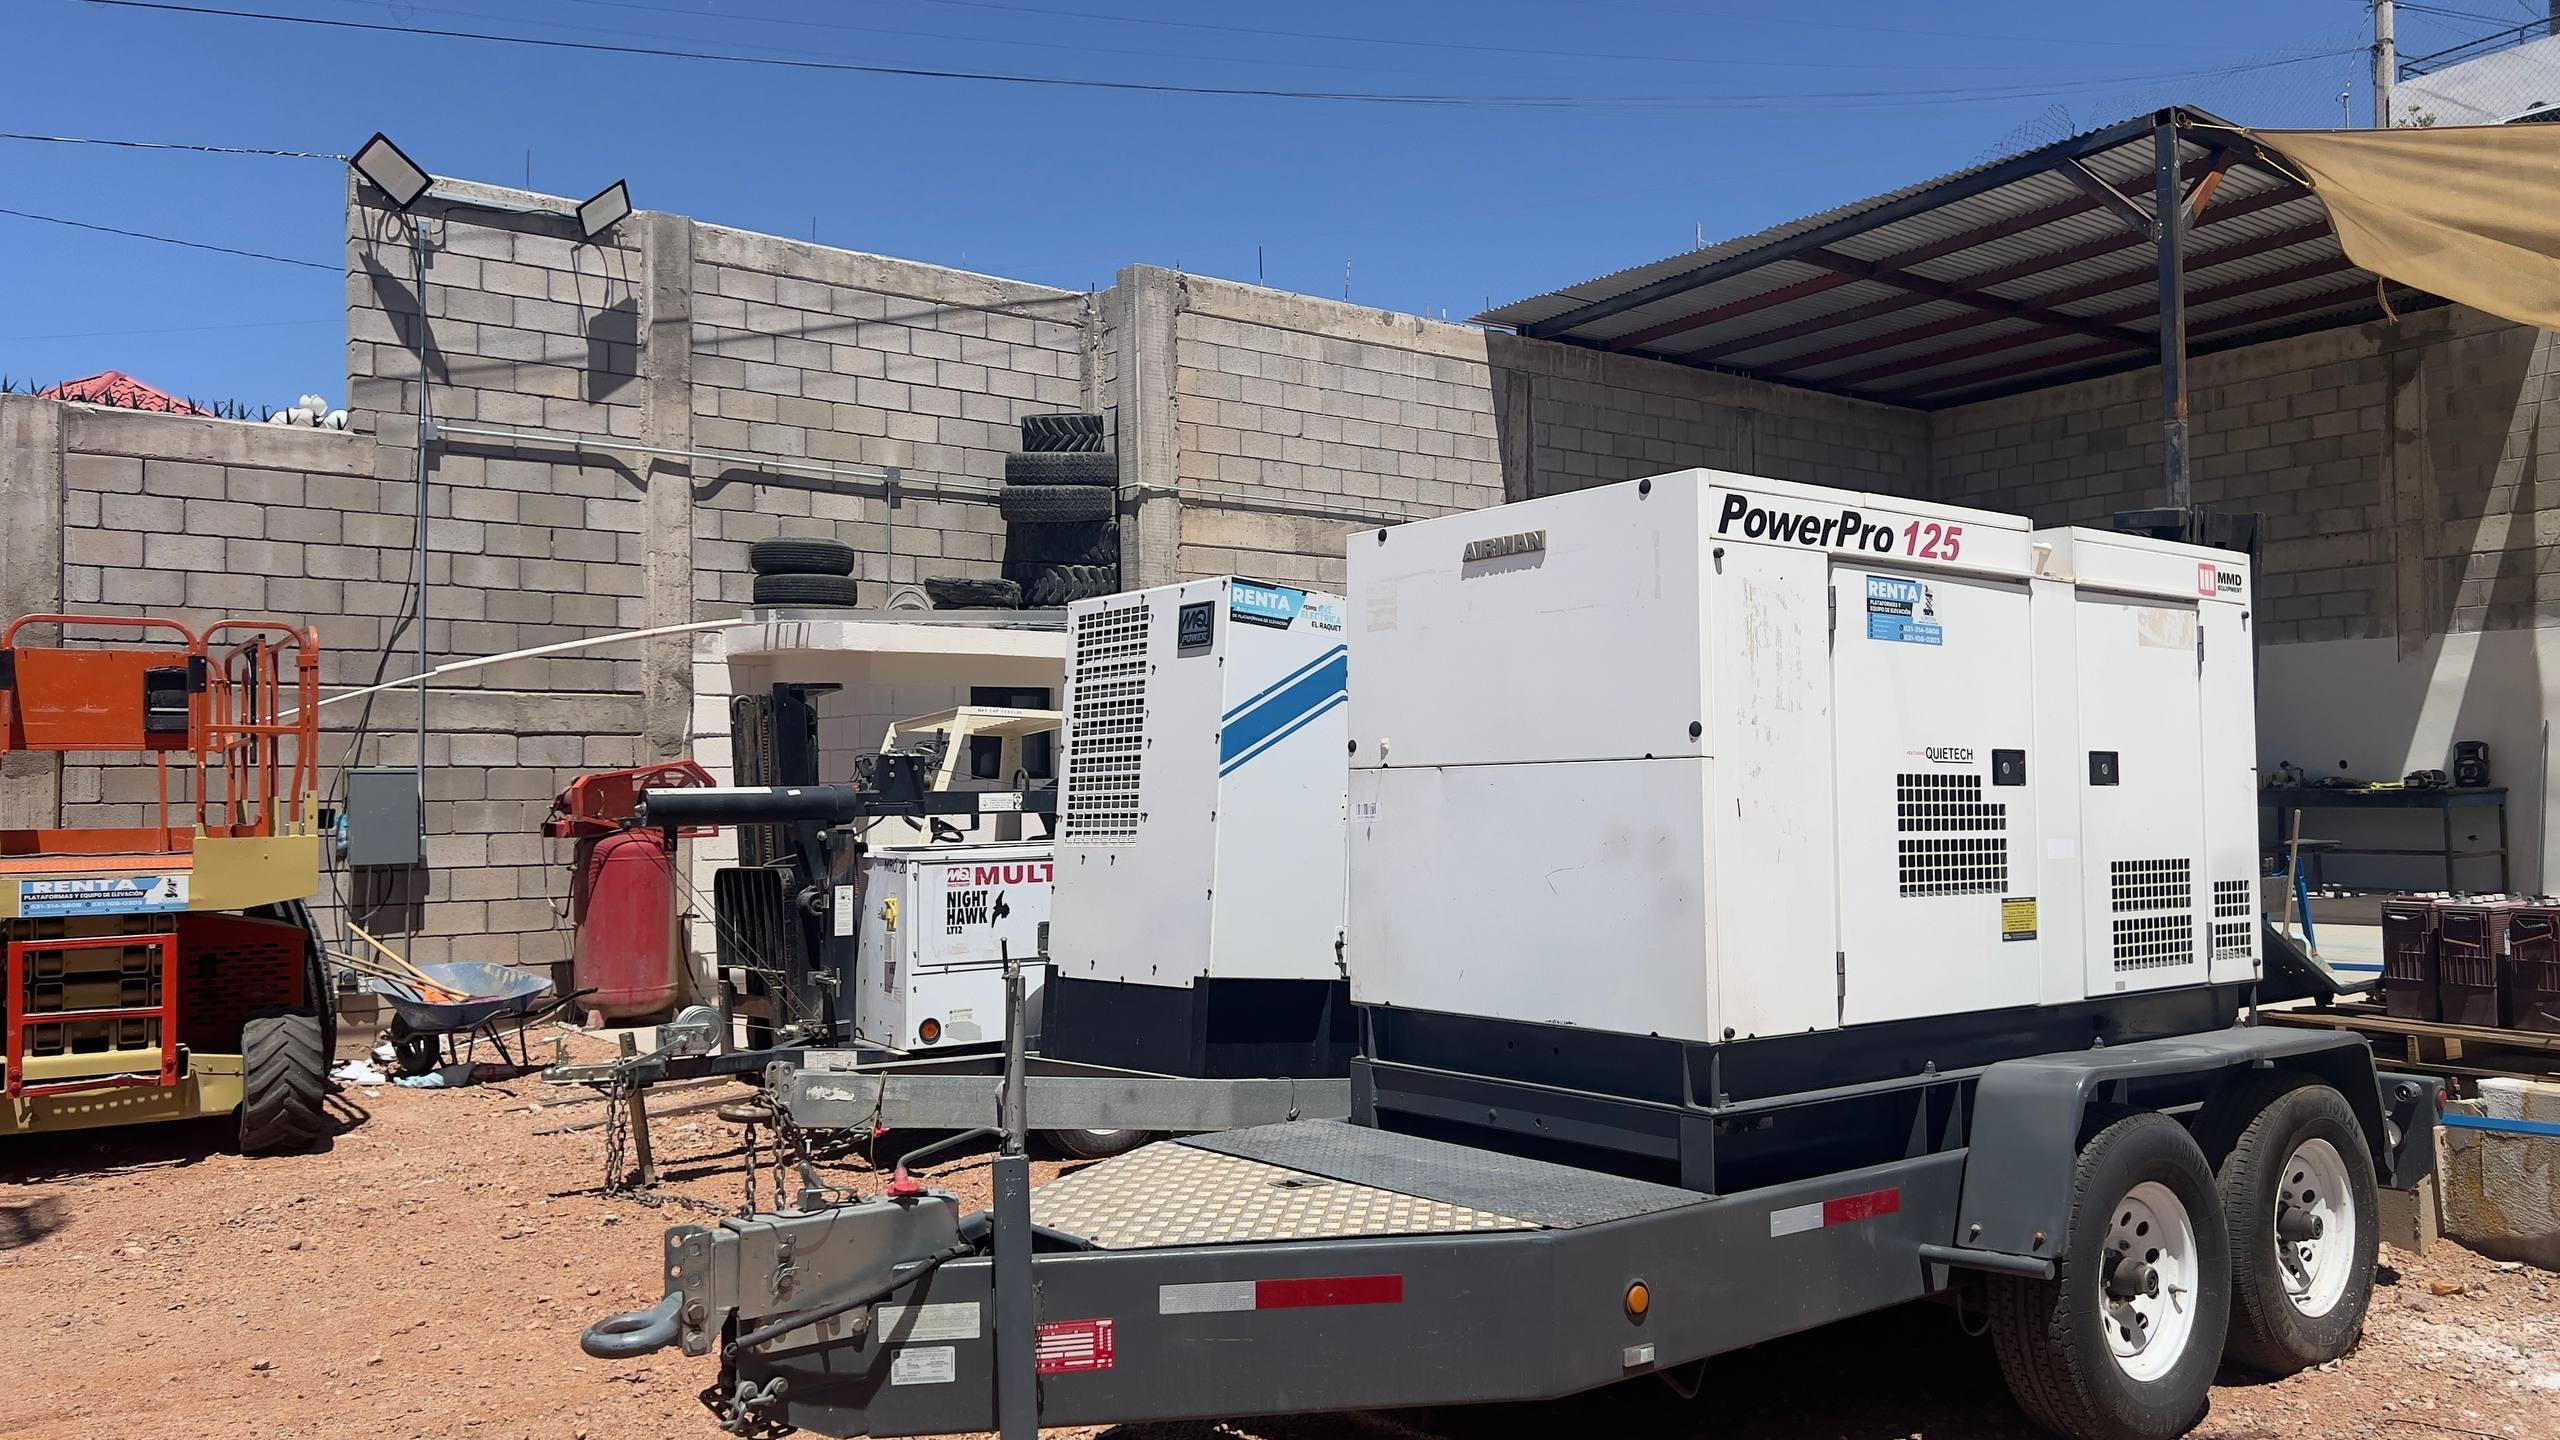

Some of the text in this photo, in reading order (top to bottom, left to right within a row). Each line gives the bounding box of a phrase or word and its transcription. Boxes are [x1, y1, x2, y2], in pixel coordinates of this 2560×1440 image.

[1718, 493, 1962, 561] PowerPro 125
[1462, 530, 1546, 562] AIRMAN
[2218, 572, 2242, 586] MMD
[1868, 580, 1919, 601] RENTA
[1233, 587, 1290, 611] RENTA
[1319, 622, 1341, 632] RAQUET
[1182, 633, 1208, 644] POWER
[1926, 747, 1973, 762] QUIETECH
[947, 867, 970, 882] MQ
[32, 879, 139, 894] RENTA
[947, 890, 988, 908] NIGHT
[947, 907, 988, 925] HAWK
[947, 926, 962, 935] LT12
